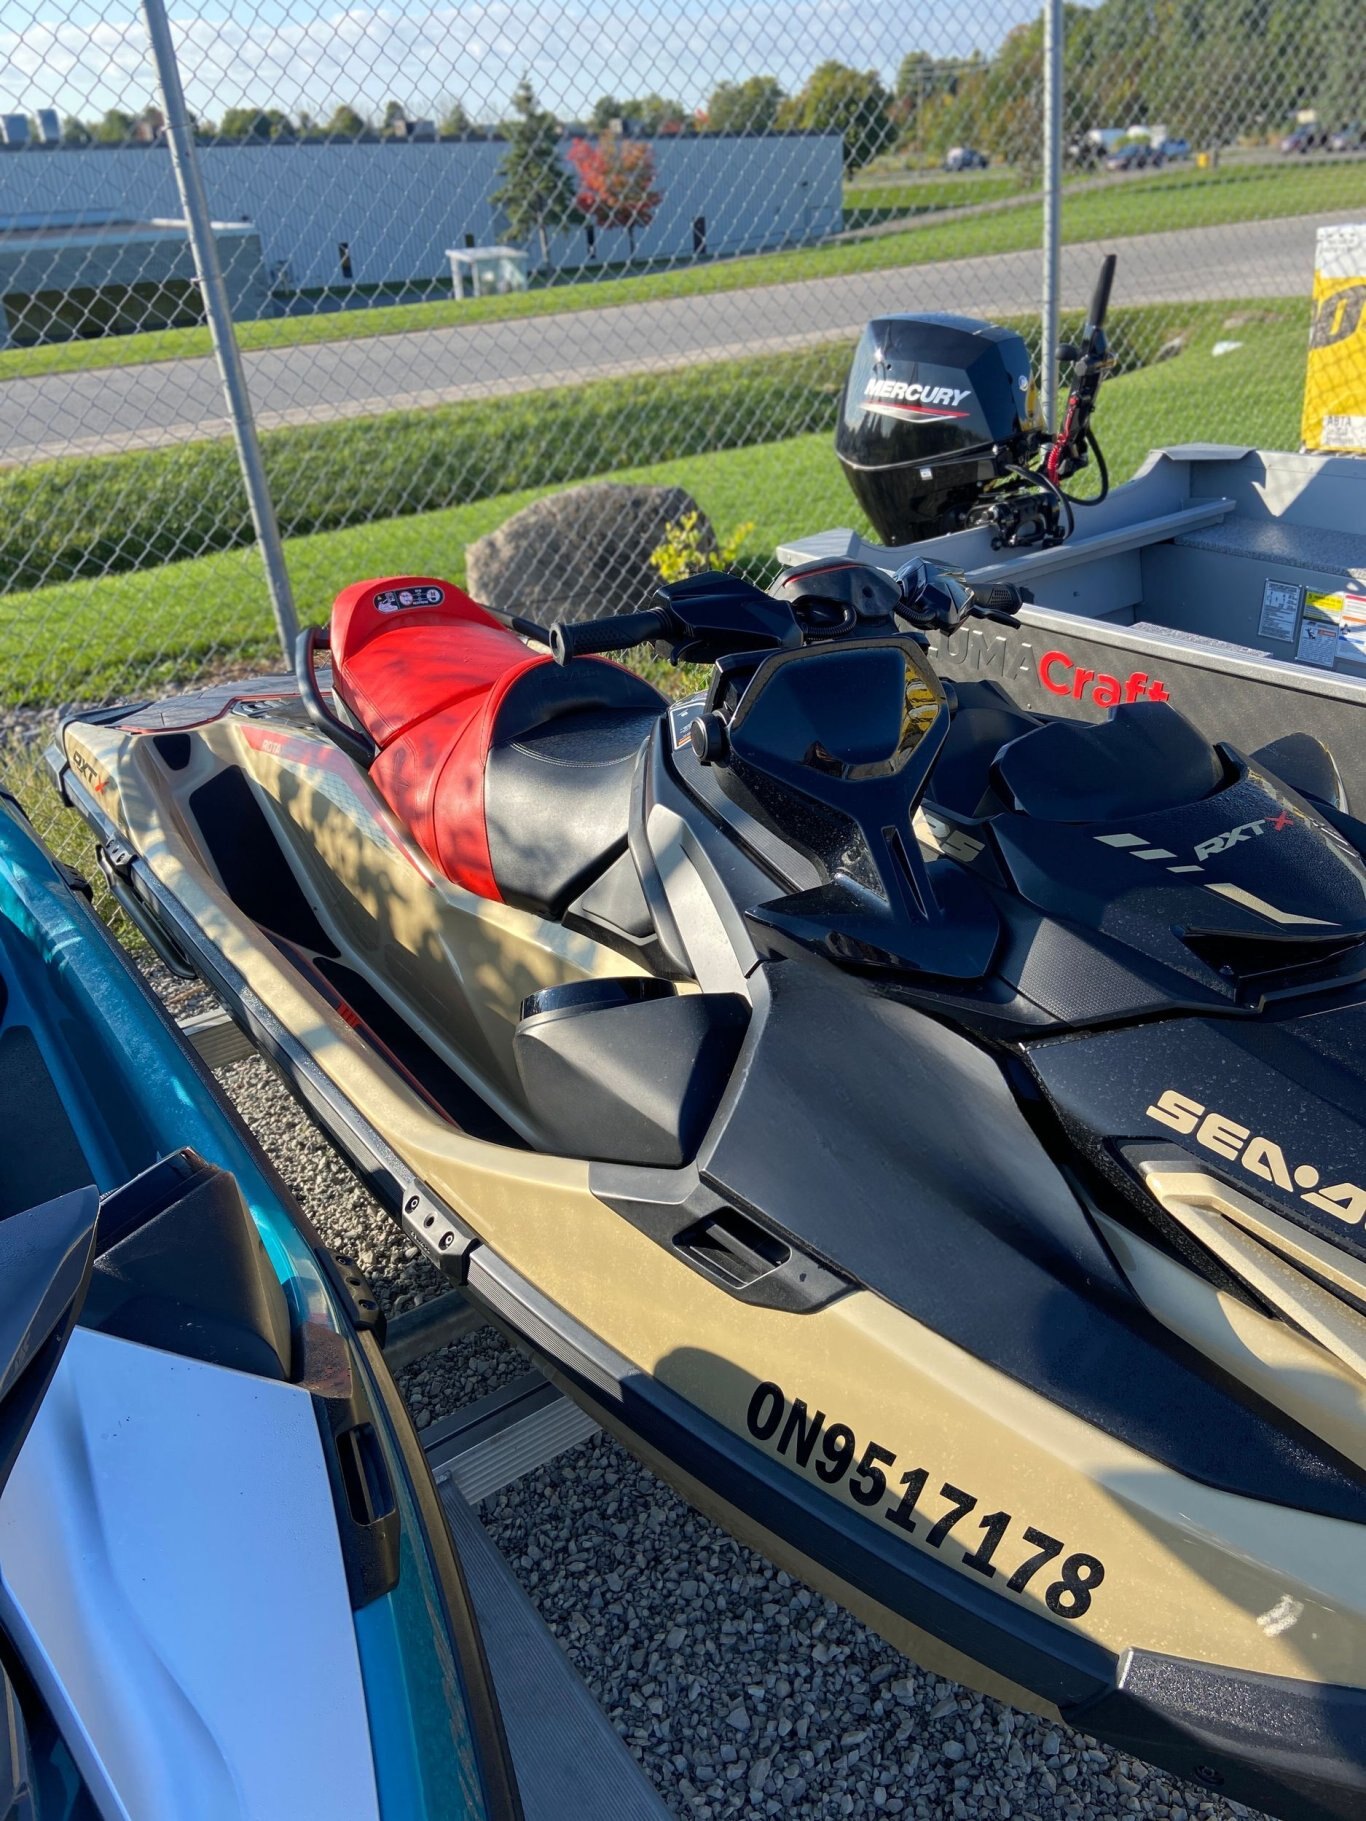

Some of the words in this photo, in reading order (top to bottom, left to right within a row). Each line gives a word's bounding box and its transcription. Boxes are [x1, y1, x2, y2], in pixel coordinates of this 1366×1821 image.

[864, 379, 972, 406] MERCURY
[1194, 819, 1266, 861] RXT
[747, 1381, 1105, 1619] ON9517178
